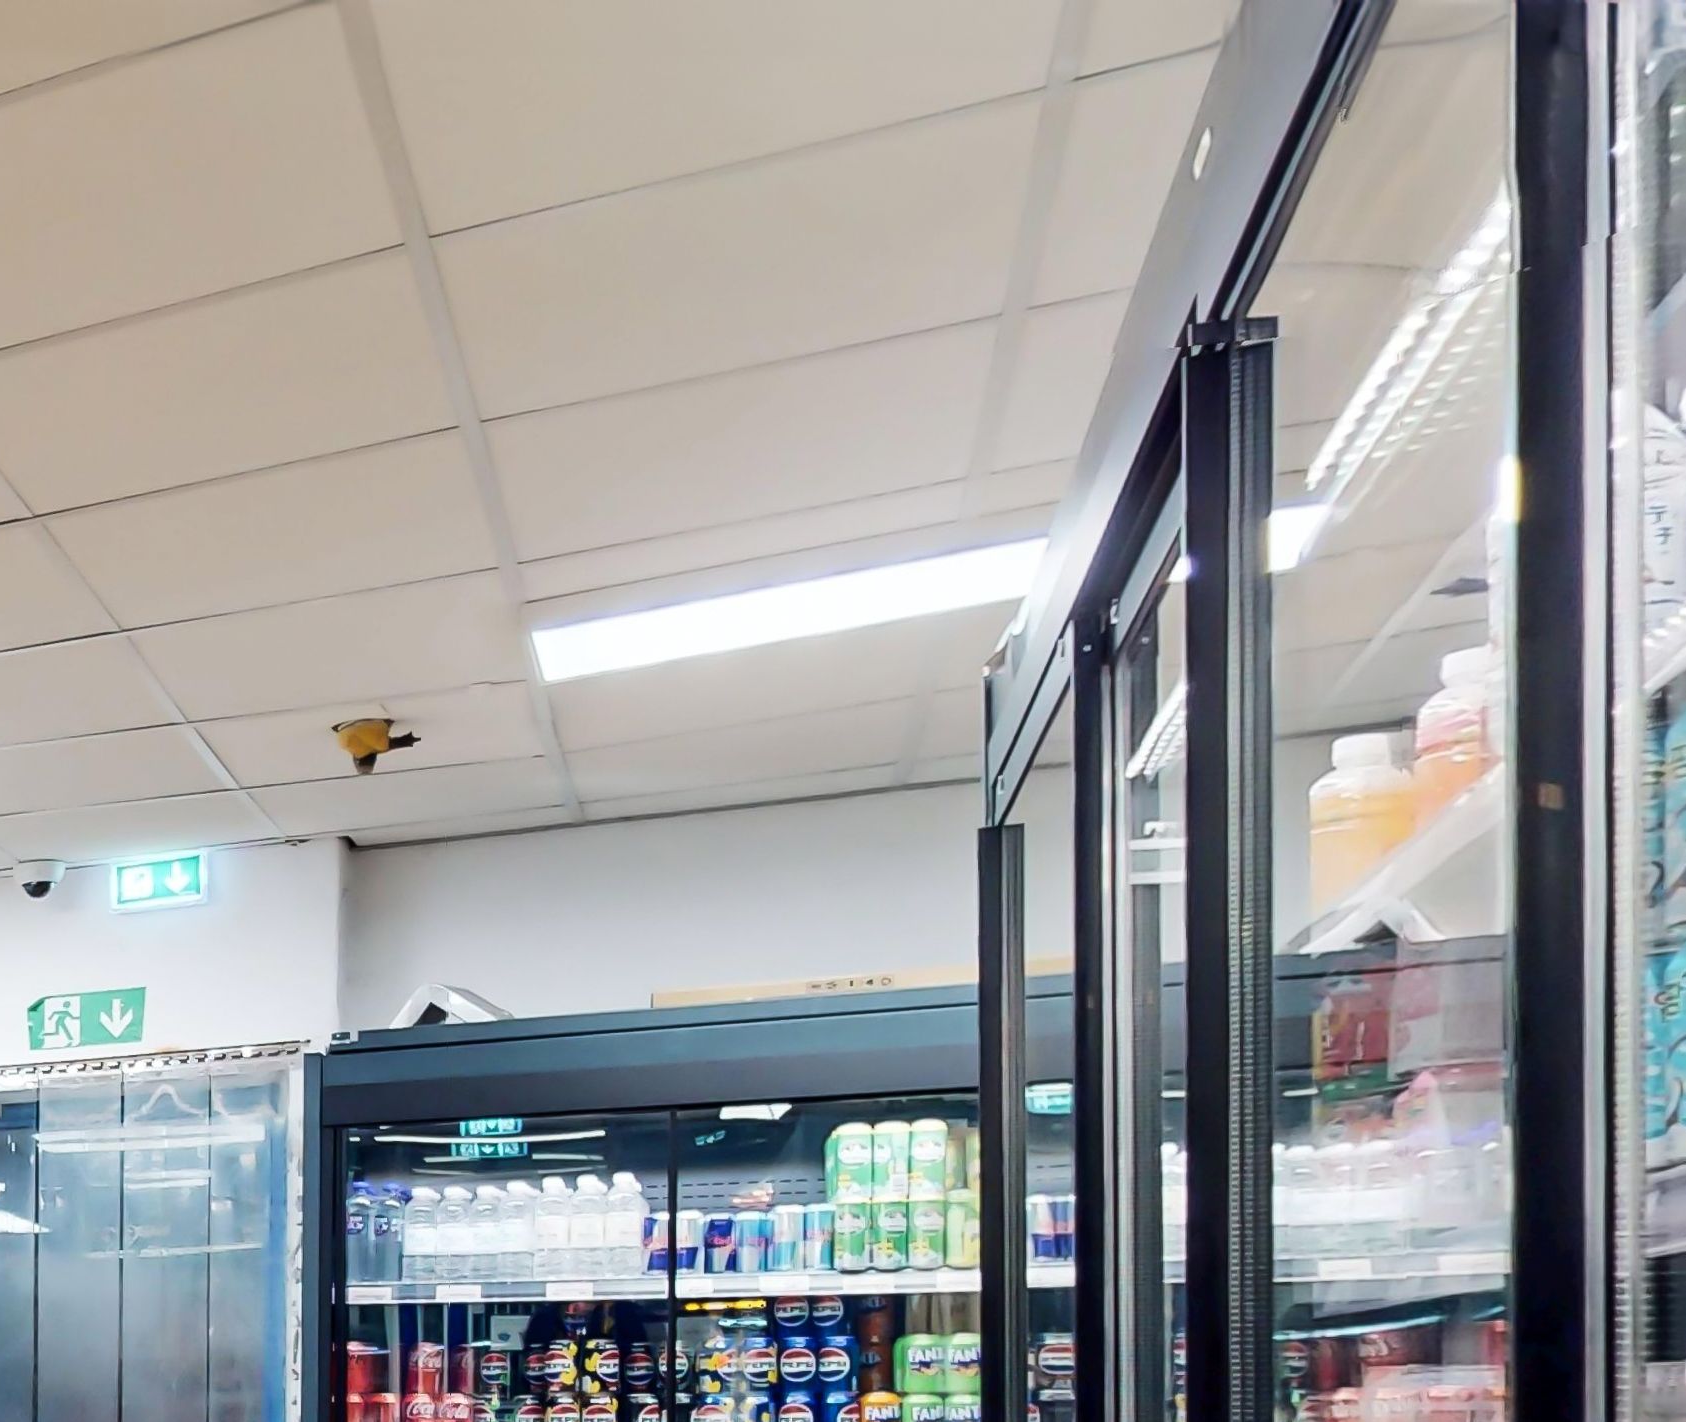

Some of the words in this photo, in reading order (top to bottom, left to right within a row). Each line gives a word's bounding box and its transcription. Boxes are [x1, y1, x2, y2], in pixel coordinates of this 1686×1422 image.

[908, 1346, 943, 1362] FANT
[948, 1346, 981, 1363] FANT
[864, 1406, 901, 1422] FANT
